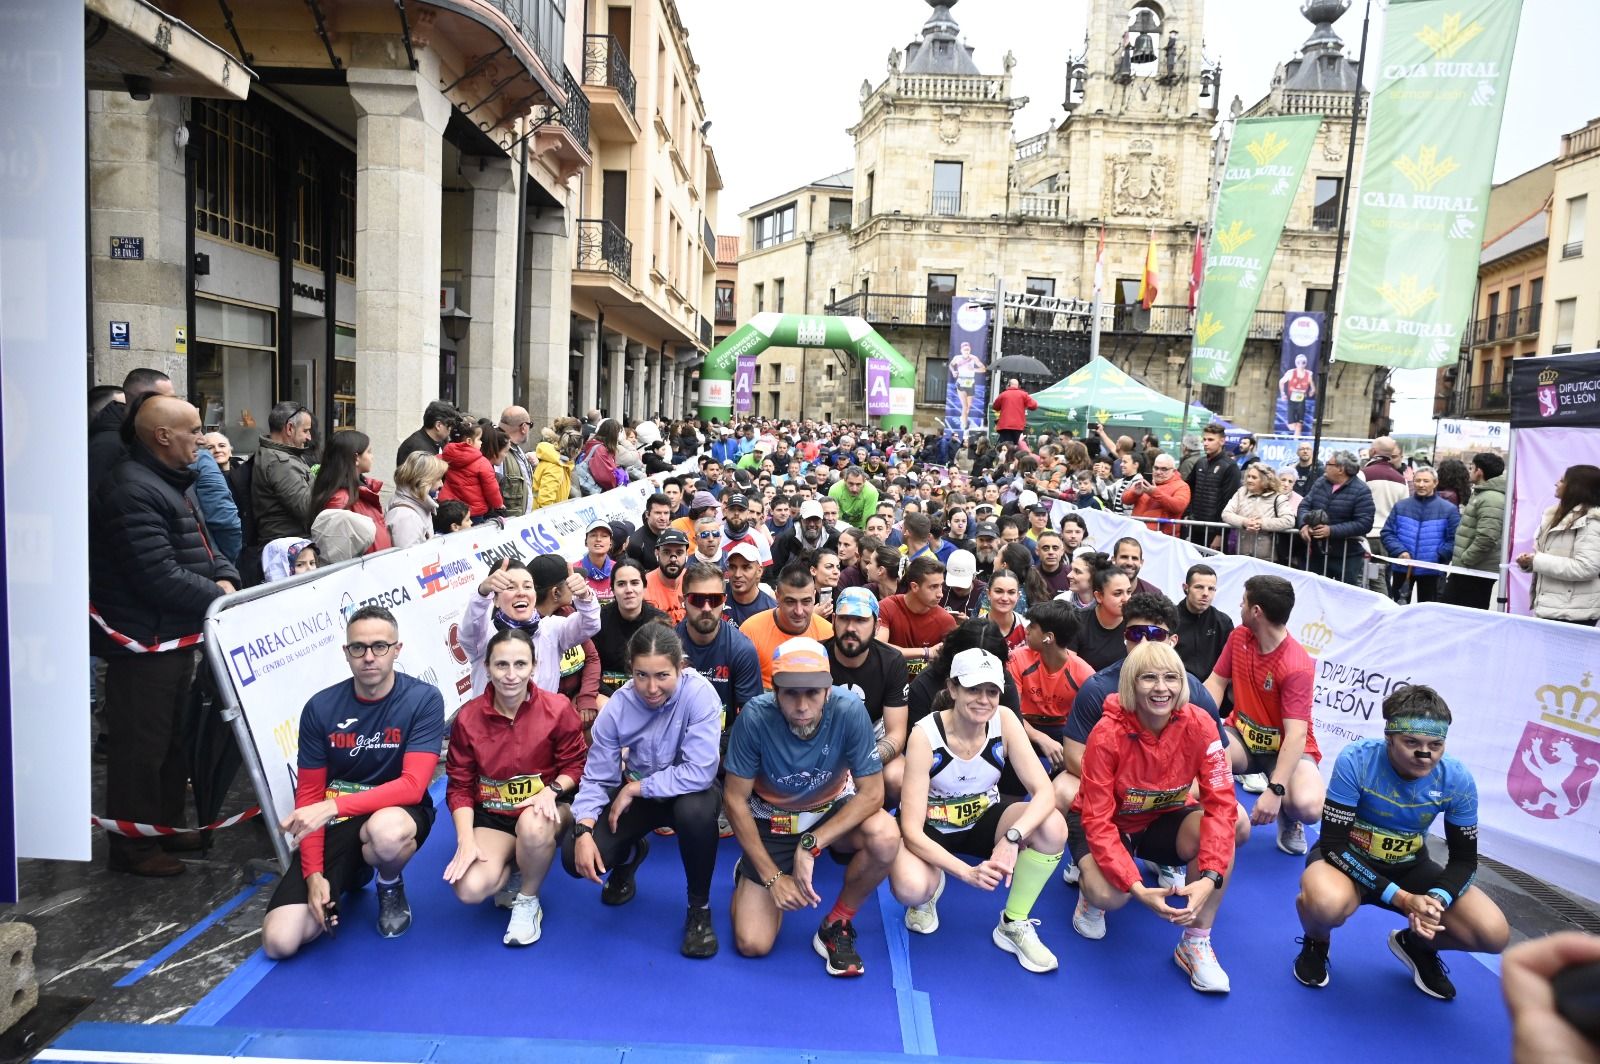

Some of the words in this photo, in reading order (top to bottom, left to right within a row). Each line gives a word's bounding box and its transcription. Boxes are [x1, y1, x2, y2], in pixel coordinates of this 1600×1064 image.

[1383, 64, 1430, 80] CAJA
[1432, 62, 1500, 78] RURAL
[1225, 168, 1250, 180] CAJA
[1254, 165, 1295, 176] RURAL
[1363, 192, 1408, 208] CAJA
[1412, 194, 1479, 212] RURAL
[1220, 256, 1262, 270] RURAL
[1344, 316, 1392, 332] CAJA
[1396, 319, 1457, 338] RURAL
[736, 373, 749, 392] A
[870, 376, 888, 396] A
[1560, 395, 1572, 405] DE
[1573, 392, 1596, 404] LEÓN
[1262, 445, 1284, 461] 10K
[716, 666, 729, 678] 26
[1326, 688, 1374, 720] LEÓN
[328, 732, 356, 748] 10K
[1248, 730, 1272, 746] 685
[508, 780, 532, 795] 677
[954, 801, 982, 819] 795
[1382, 838, 1414, 852] 821
